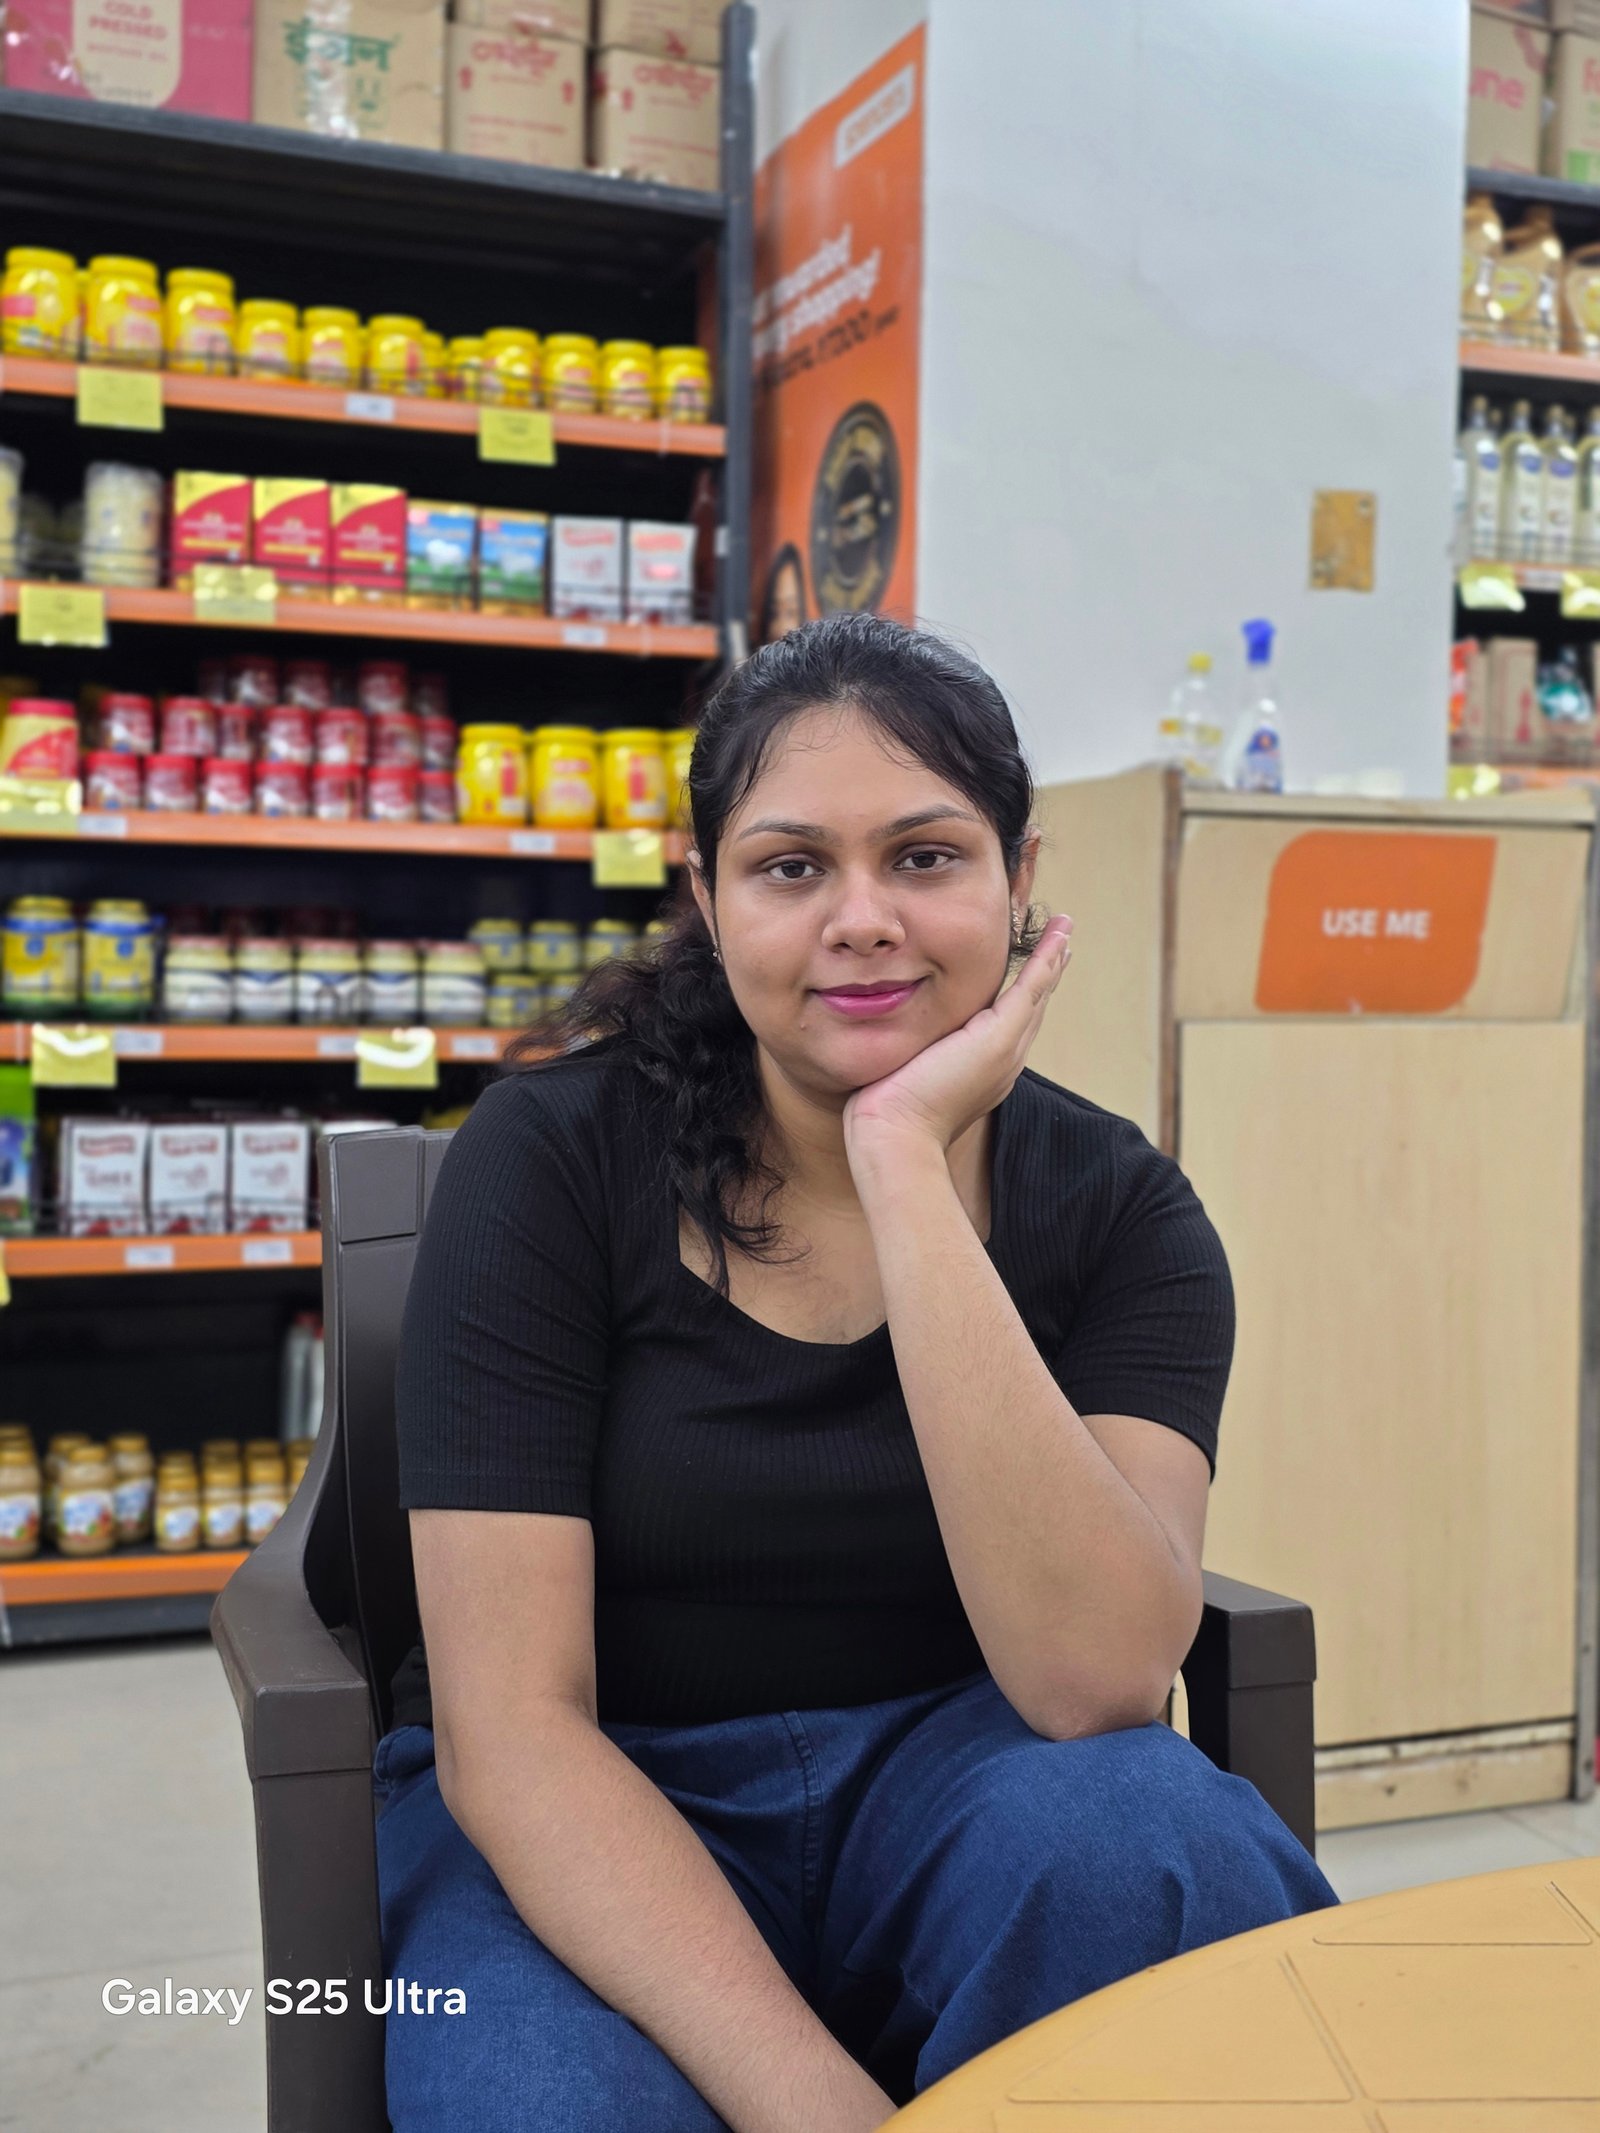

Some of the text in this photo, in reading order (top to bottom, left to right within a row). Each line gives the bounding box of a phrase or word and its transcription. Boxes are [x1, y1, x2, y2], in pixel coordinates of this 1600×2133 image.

[104, 1, 153, 20] COLD
[88, 15, 168, 41] PRESSED
[1322, 906, 1430, 941] USE ME
